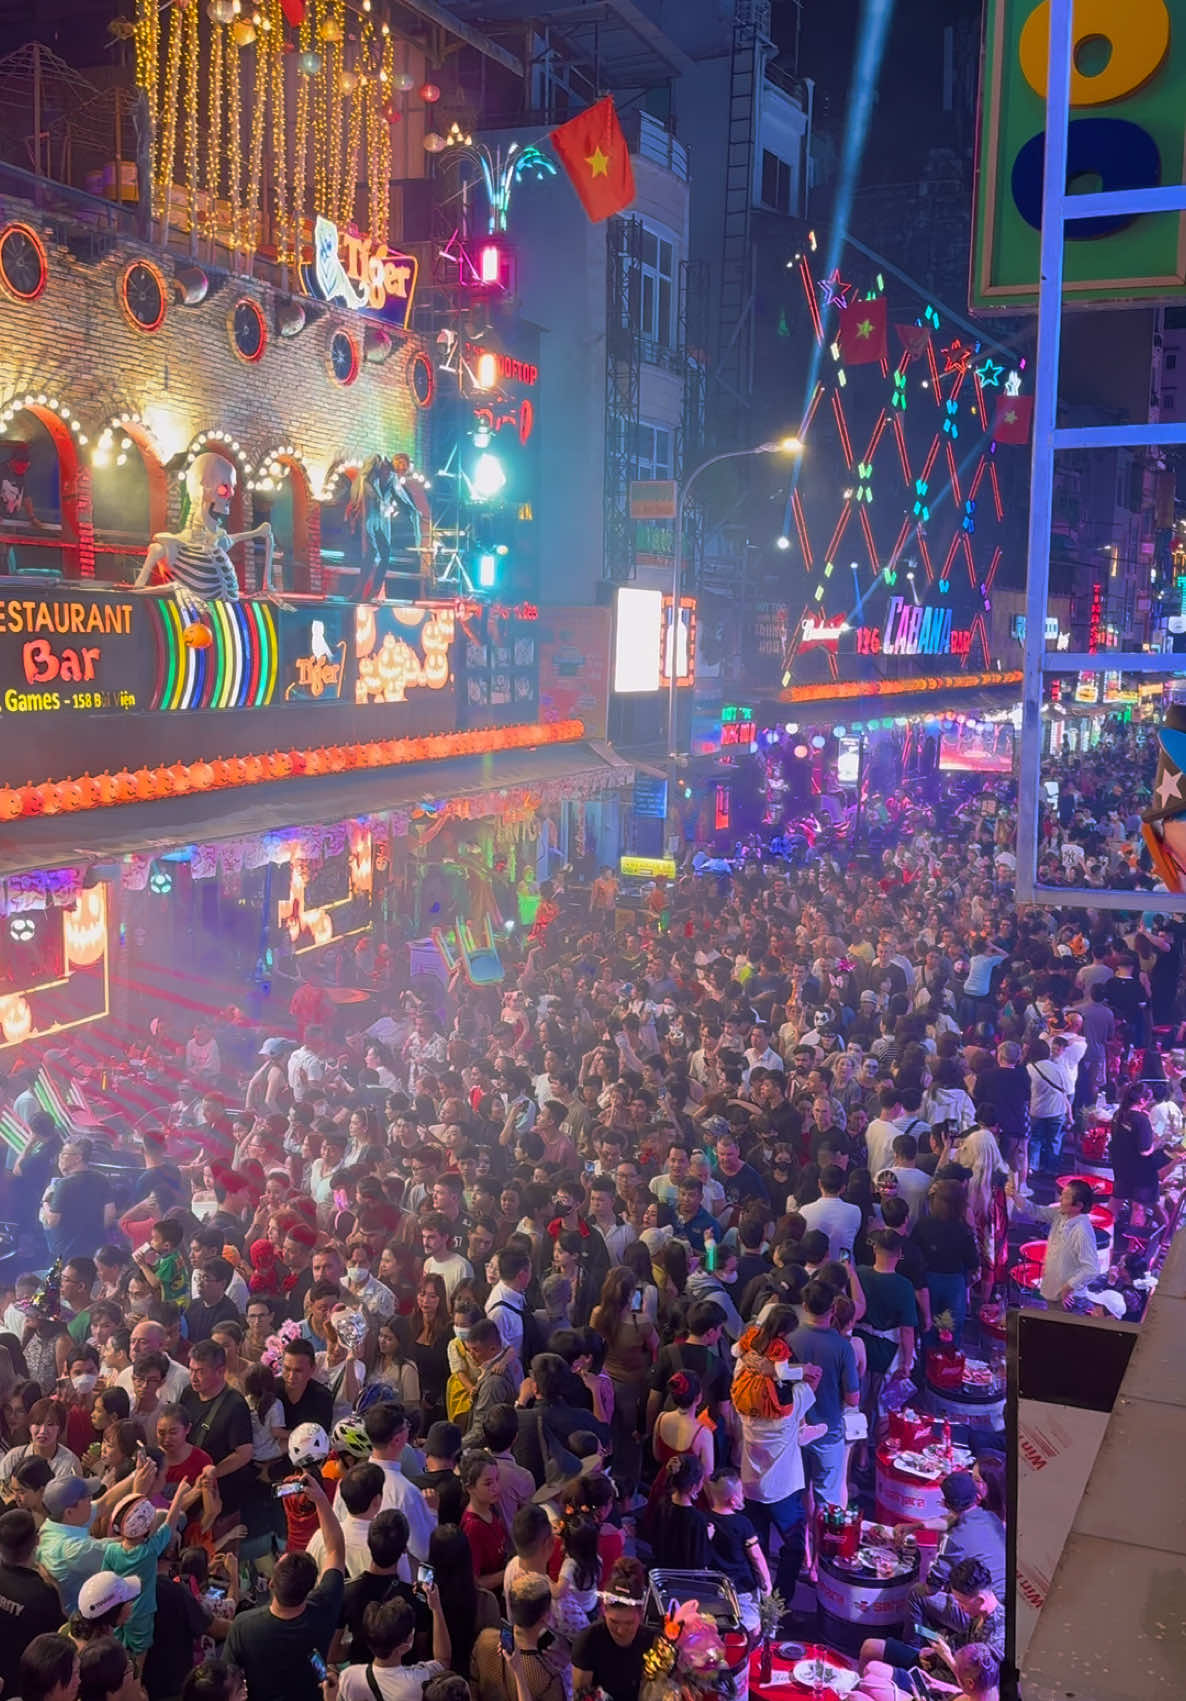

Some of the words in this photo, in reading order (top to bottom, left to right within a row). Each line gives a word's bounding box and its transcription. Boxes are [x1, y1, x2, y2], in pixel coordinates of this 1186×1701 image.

[883, 596, 952, 655] CABANA
[23, 639, 100, 684] Bar
[296, 656, 340, 697] Tiger
[4, 689, 60, 712] Games
[72, 693, 92, 709] 158
